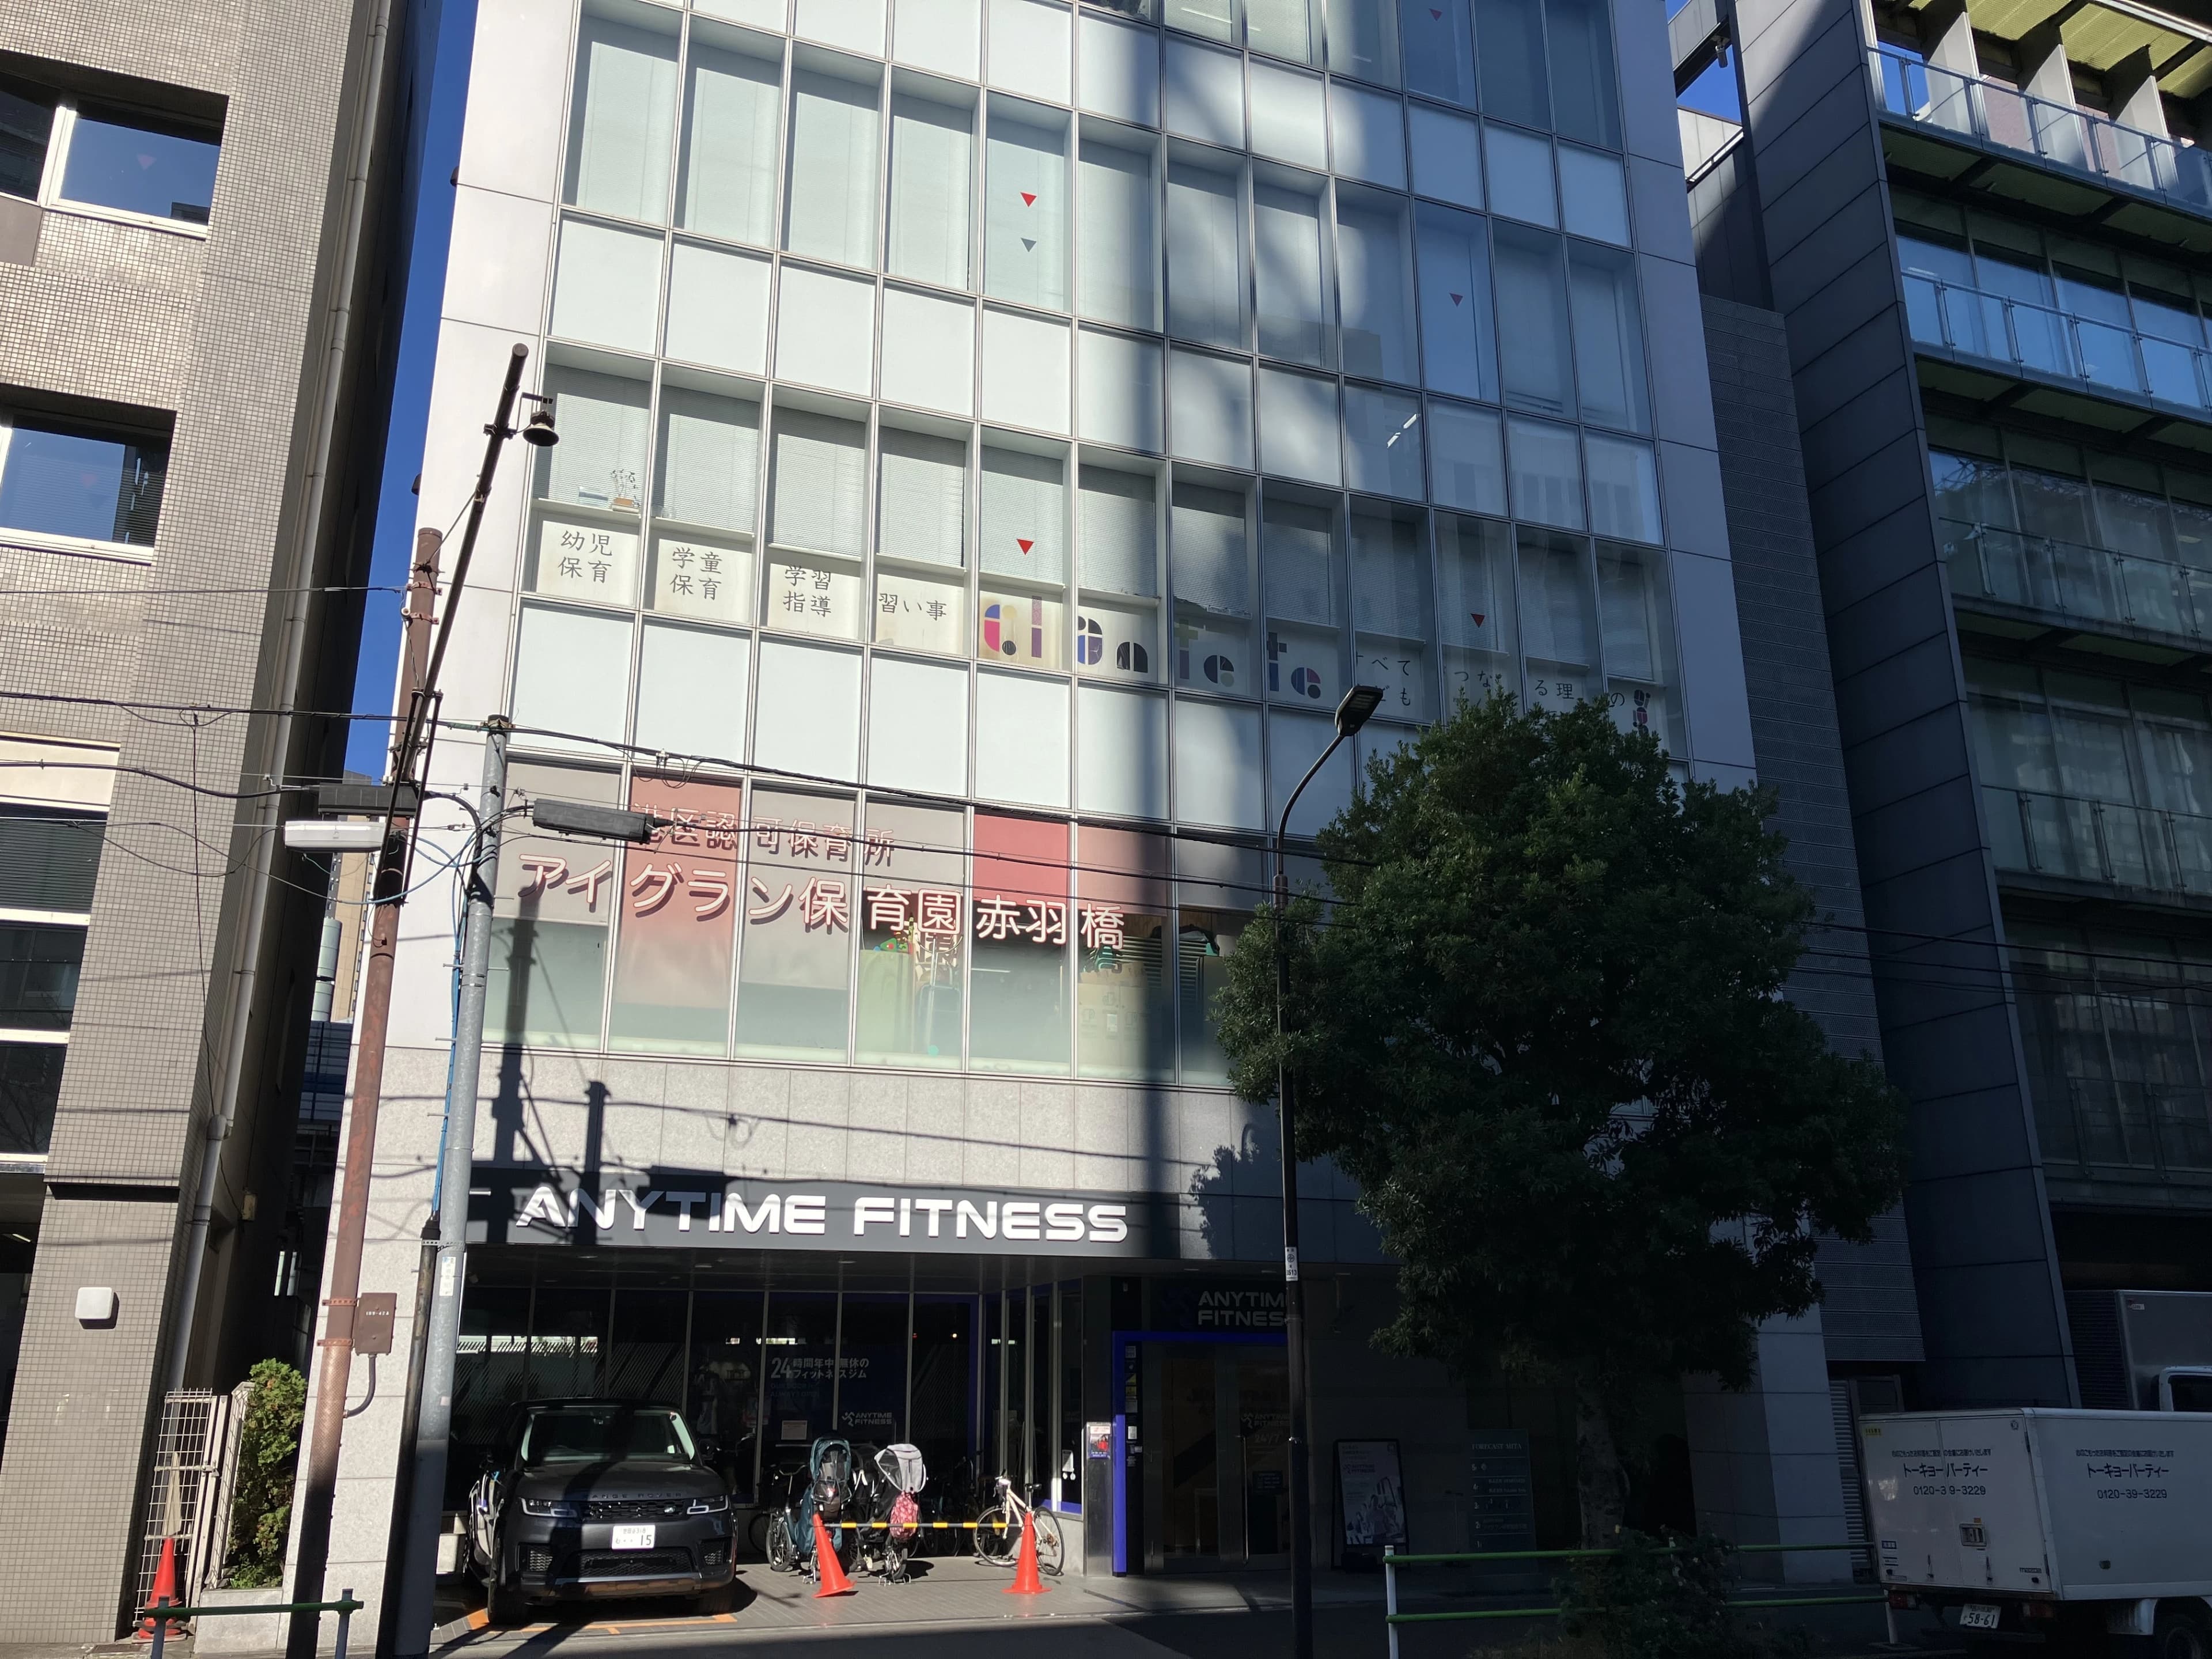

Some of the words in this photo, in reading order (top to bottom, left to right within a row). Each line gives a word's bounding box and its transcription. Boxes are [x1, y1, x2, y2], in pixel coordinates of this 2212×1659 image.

[560, 530, 613, 558] 幼児
[558, 555, 613, 584] 保育
[671, 546, 723, 575] 学童
[668, 573, 722, 601] 保育
[783, 565, 833, 591] 学習
[782, 589, 833, 617] 指導
[878, 592, 948, 622] 習い事
[519, 854, 1125, 950] アイグラン保育園赤羽橋
[516, 1185, 825, 1236] ANYTIME
[854, 1194, 1128, 1244] FITNESS
[1198, 1291, 1286, 1308] ANYTIM
[1198, 1310, 1286, 1326] FITNES
[1913, 1486, 1986, 1495] 0120-39-3229
[2097, 1489, 2167, 1499] 0120-39-3229
[1967, 1612, 1995, 1626] 58-61
